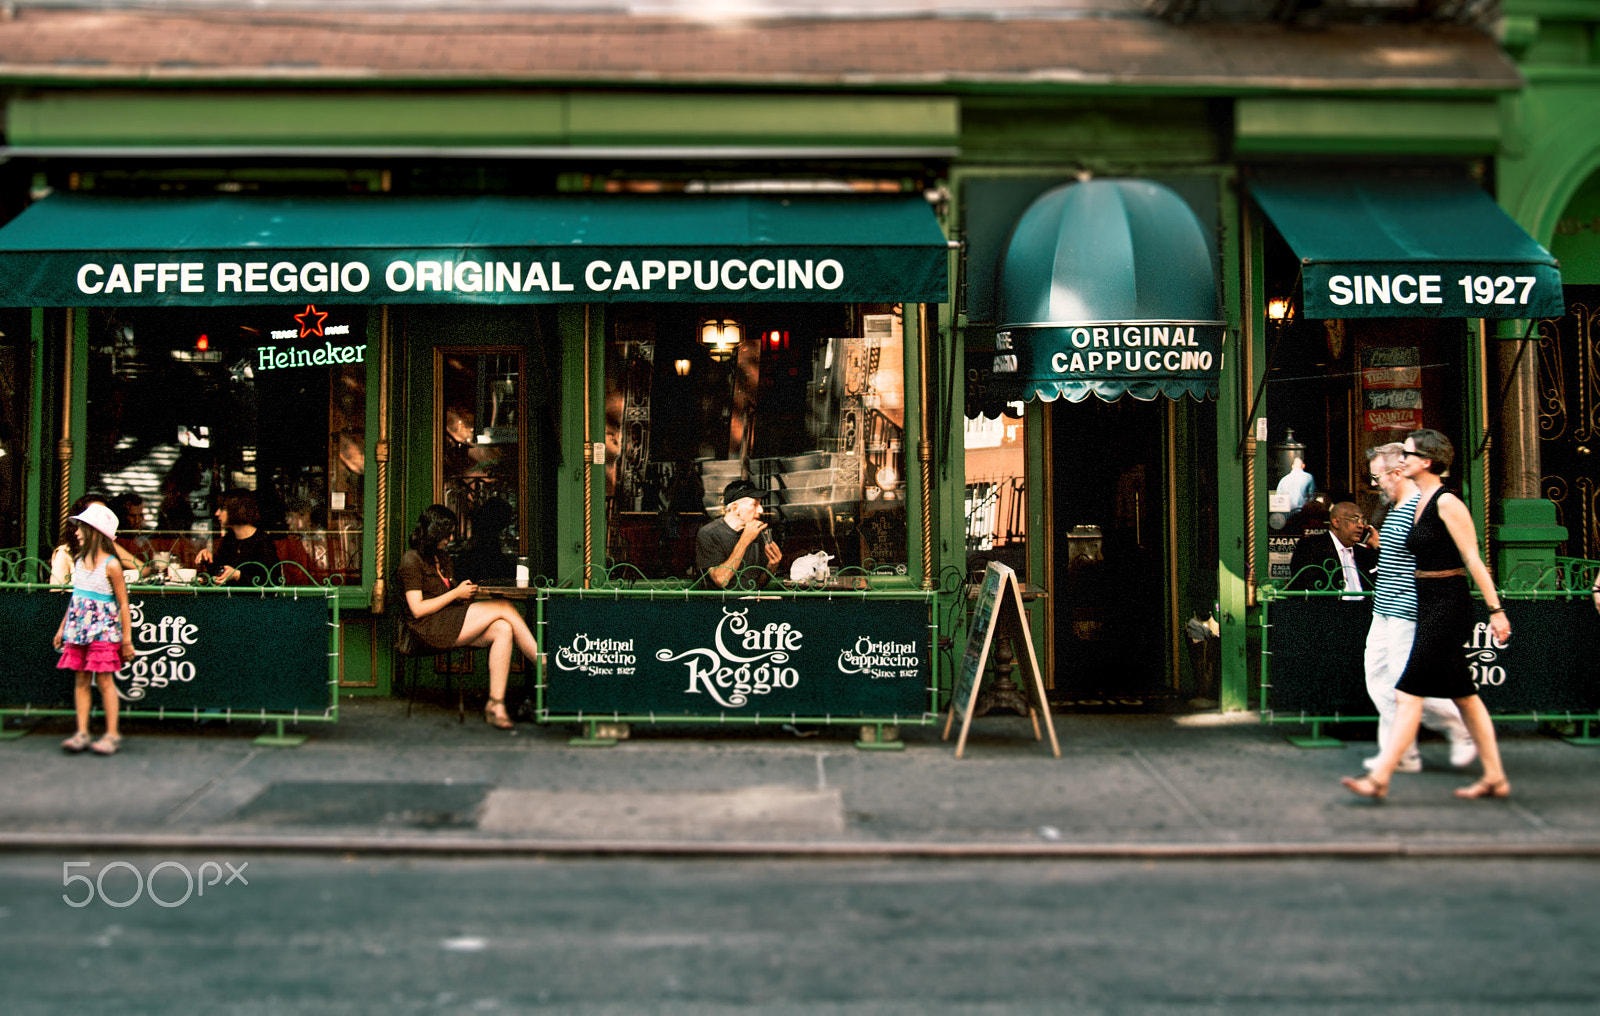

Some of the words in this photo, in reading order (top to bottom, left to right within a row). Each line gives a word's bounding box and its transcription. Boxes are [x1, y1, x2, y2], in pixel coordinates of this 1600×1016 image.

[77, 263, 204, 294] CAFFE
[217, 262, 369, 292] REGGIO
[385, 261, 573, 292] ORIGINAL
[584, 259, 844, 291] CAPPUCCINO
[1328, 274, 1442, 305] SINCE
[1458, 276, 1536, 304] 1927
[1071, 327, 1199, 349] ORIGINAL
[1051, 351, 1213, 373] CAPPUCCINO
[573, 633, 634, 653] Original
[715, 606, 803, 664] Caffe
[855, 635, 916, 656] Original
[555, 645, 636, 671] Cappuccino
[837, 649, 919, 674] Cappuccino
[588, 665, 613, 676] Since
[656, 648, 799, 707] Reggio
[871, 669, 896, 679] Since
